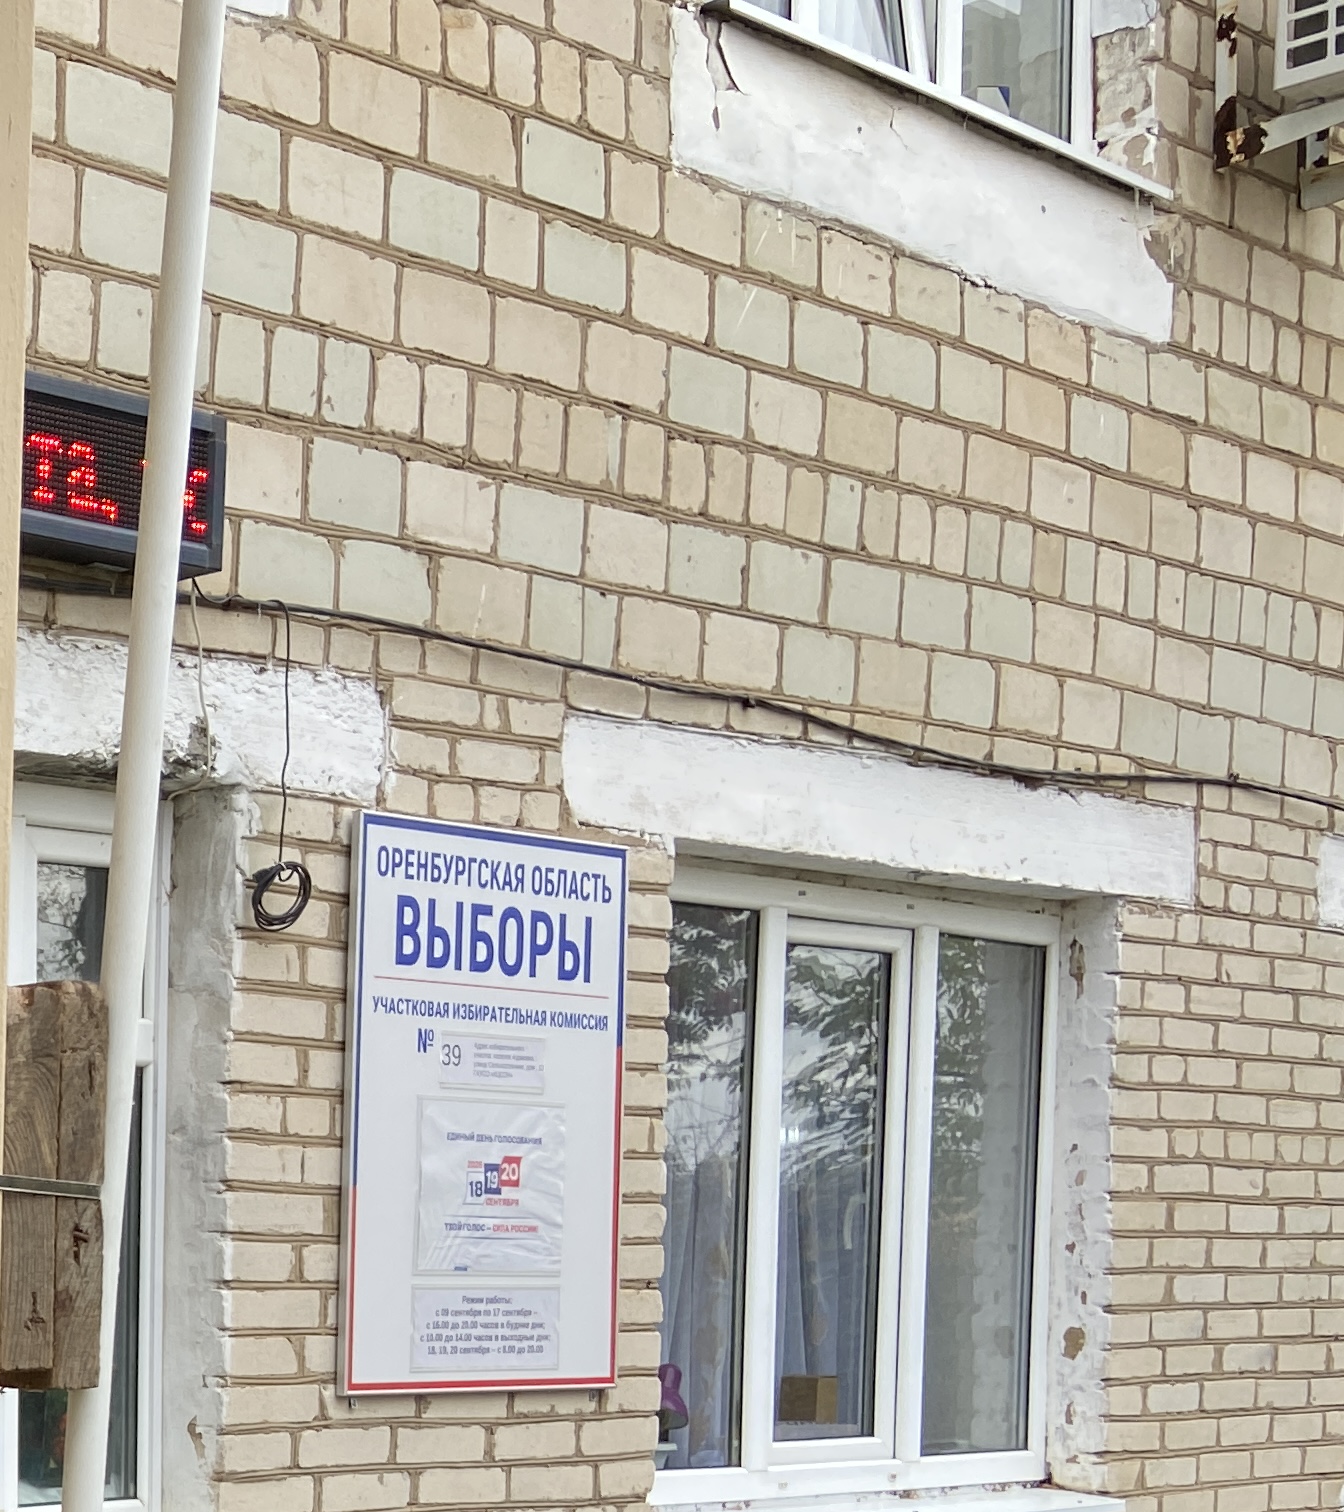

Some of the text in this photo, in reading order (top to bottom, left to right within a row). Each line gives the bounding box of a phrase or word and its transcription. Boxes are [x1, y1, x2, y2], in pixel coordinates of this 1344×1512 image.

[377, 845, 612, 904] ОРЕНБУРГСКАЯ ОБЛАСТЬ
[394, 894, 592, 984] ВЫБОРЫ
[372, 994, 608, 1032] УЧАСТКОВАЯ ИЗБИРАТЕЛЬНАЯ КОМИССИЯ
[441, 1043, 462, 1067] 39
[469, 1181, 483, 1198] 18
[486, 1170, 498, 1189] 19
[500, 1163, 519, 1181] 20
